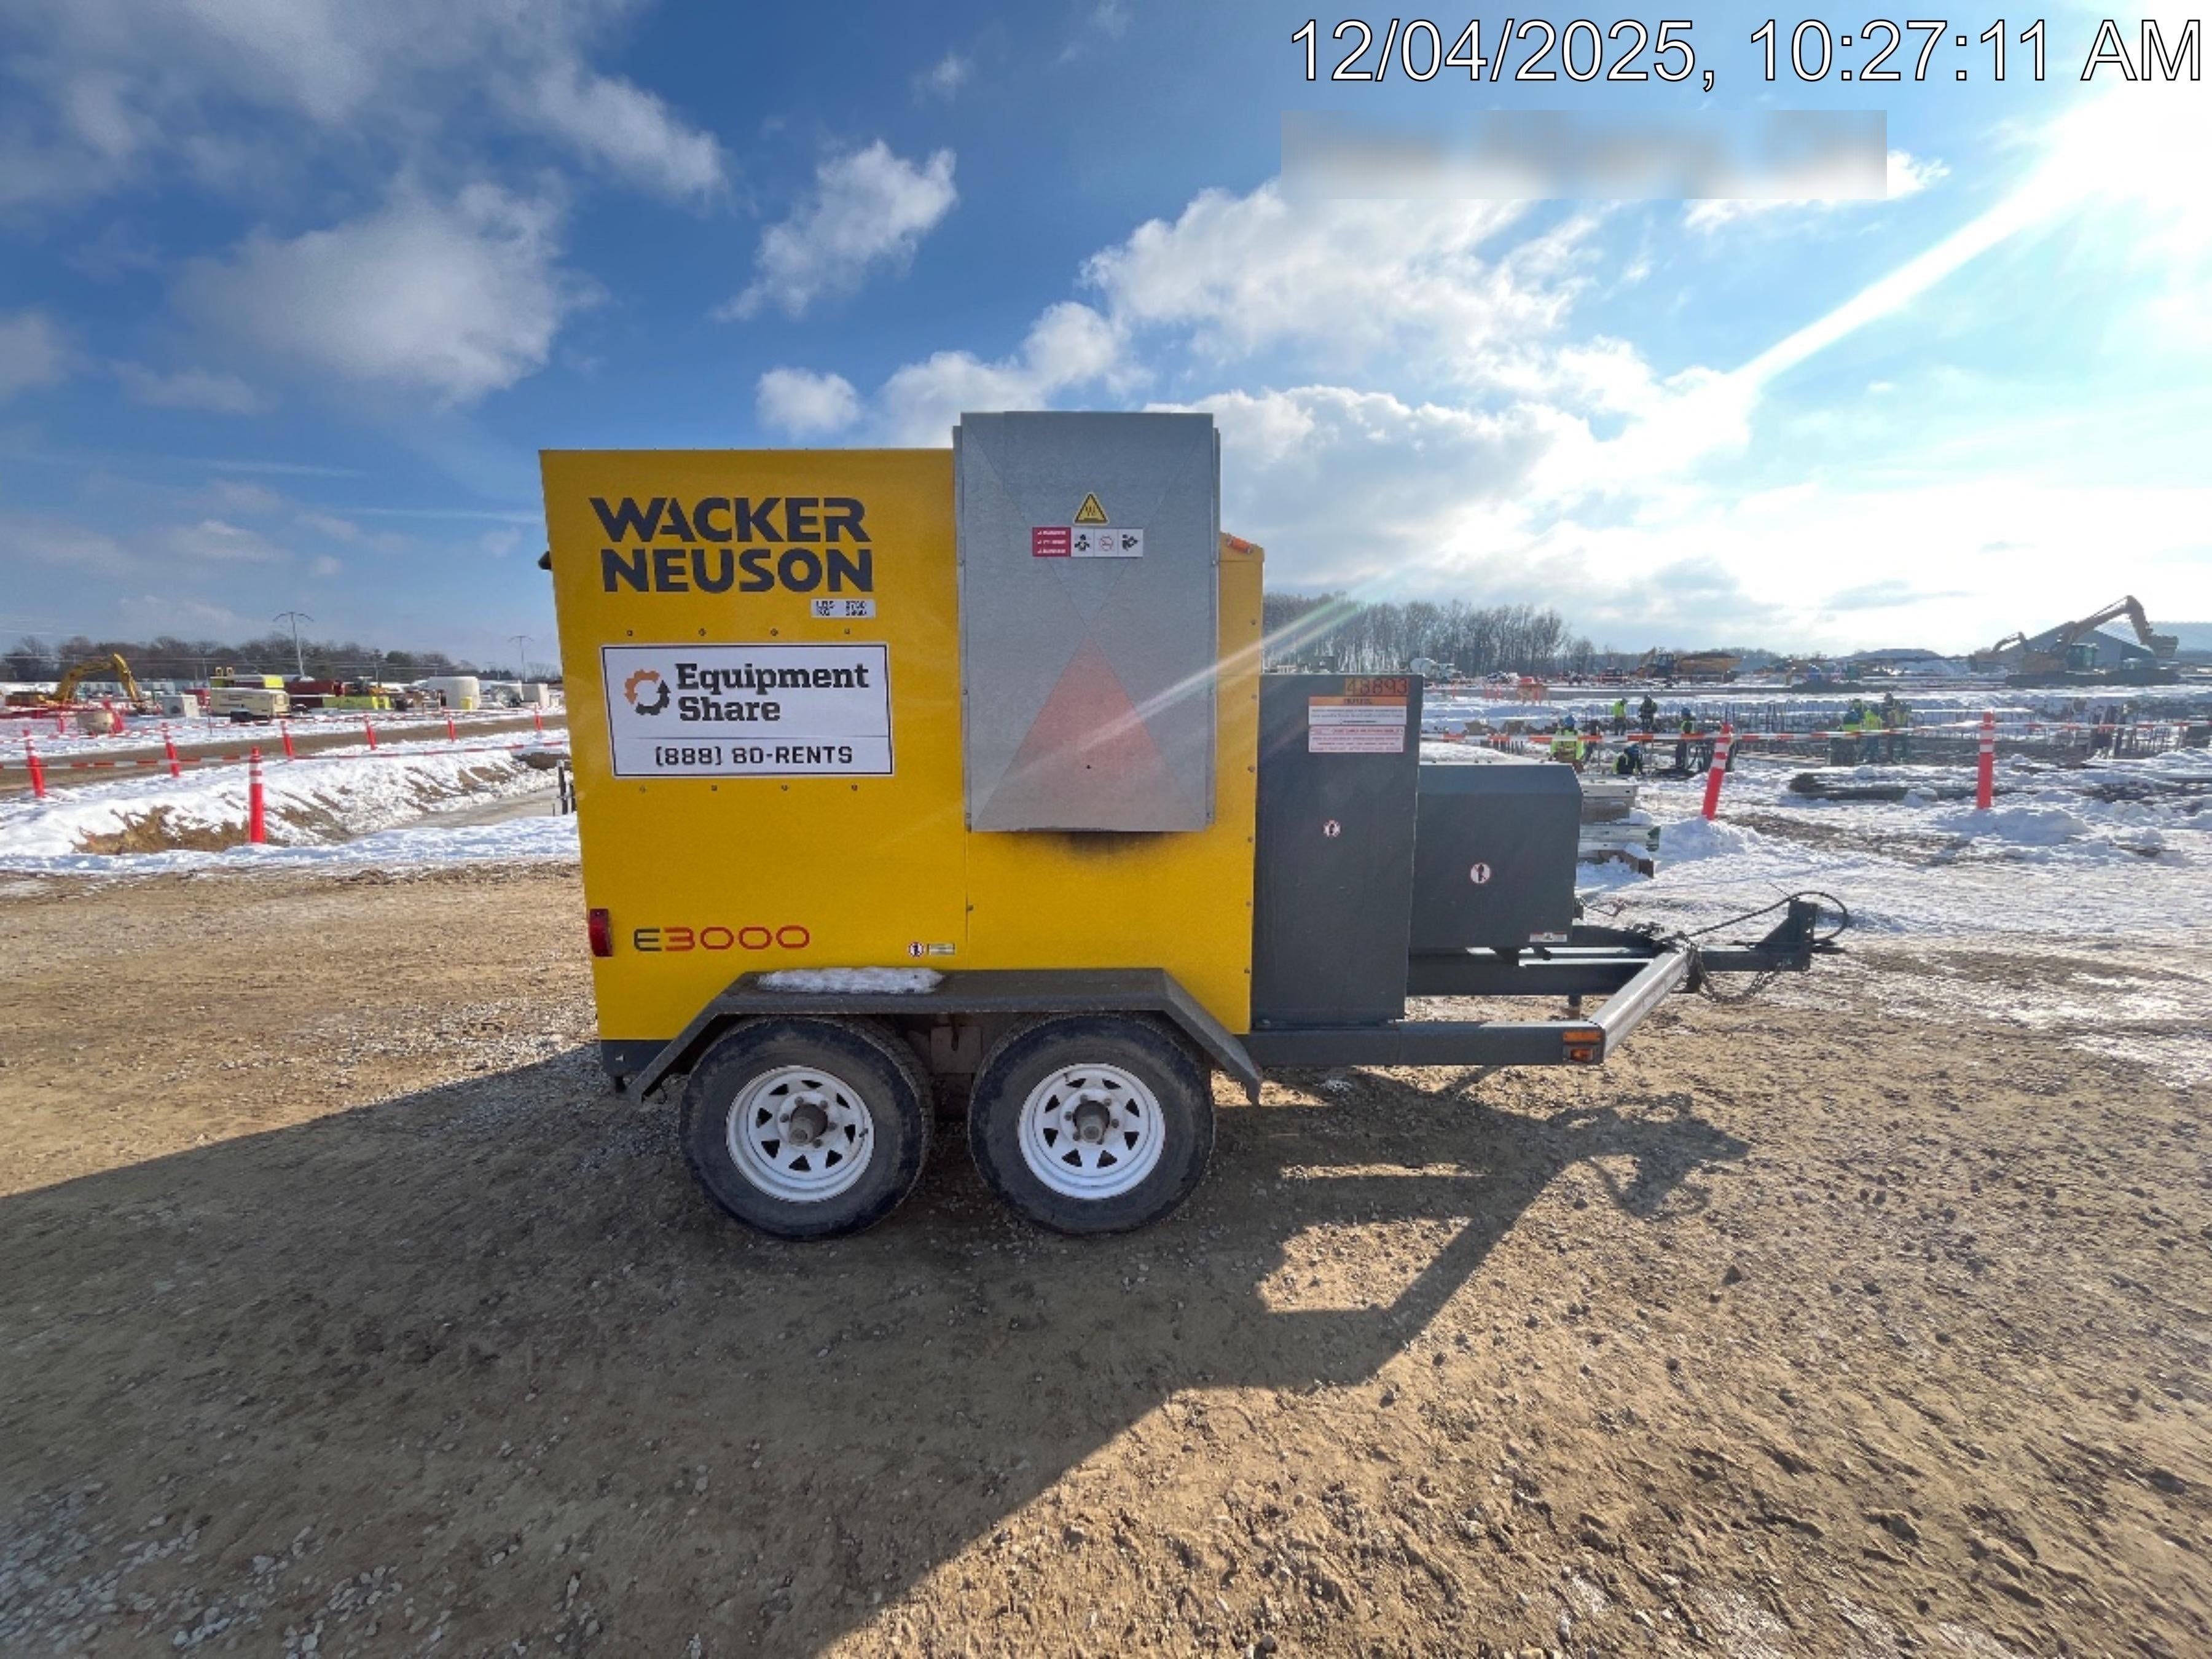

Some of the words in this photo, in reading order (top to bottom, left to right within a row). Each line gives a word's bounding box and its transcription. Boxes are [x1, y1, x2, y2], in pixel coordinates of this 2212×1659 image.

[589, 497, 872, 543] WACKER
[601, 548, 873, 593] NEUSON
[675, 663, 869, 696] Equipment
[678, 696, 780, 721] Share
[655, 746, 723, 767] (888)
[731, 745, 852, 764] 80-RENTS
[633, 925, 810, 952] E3000
